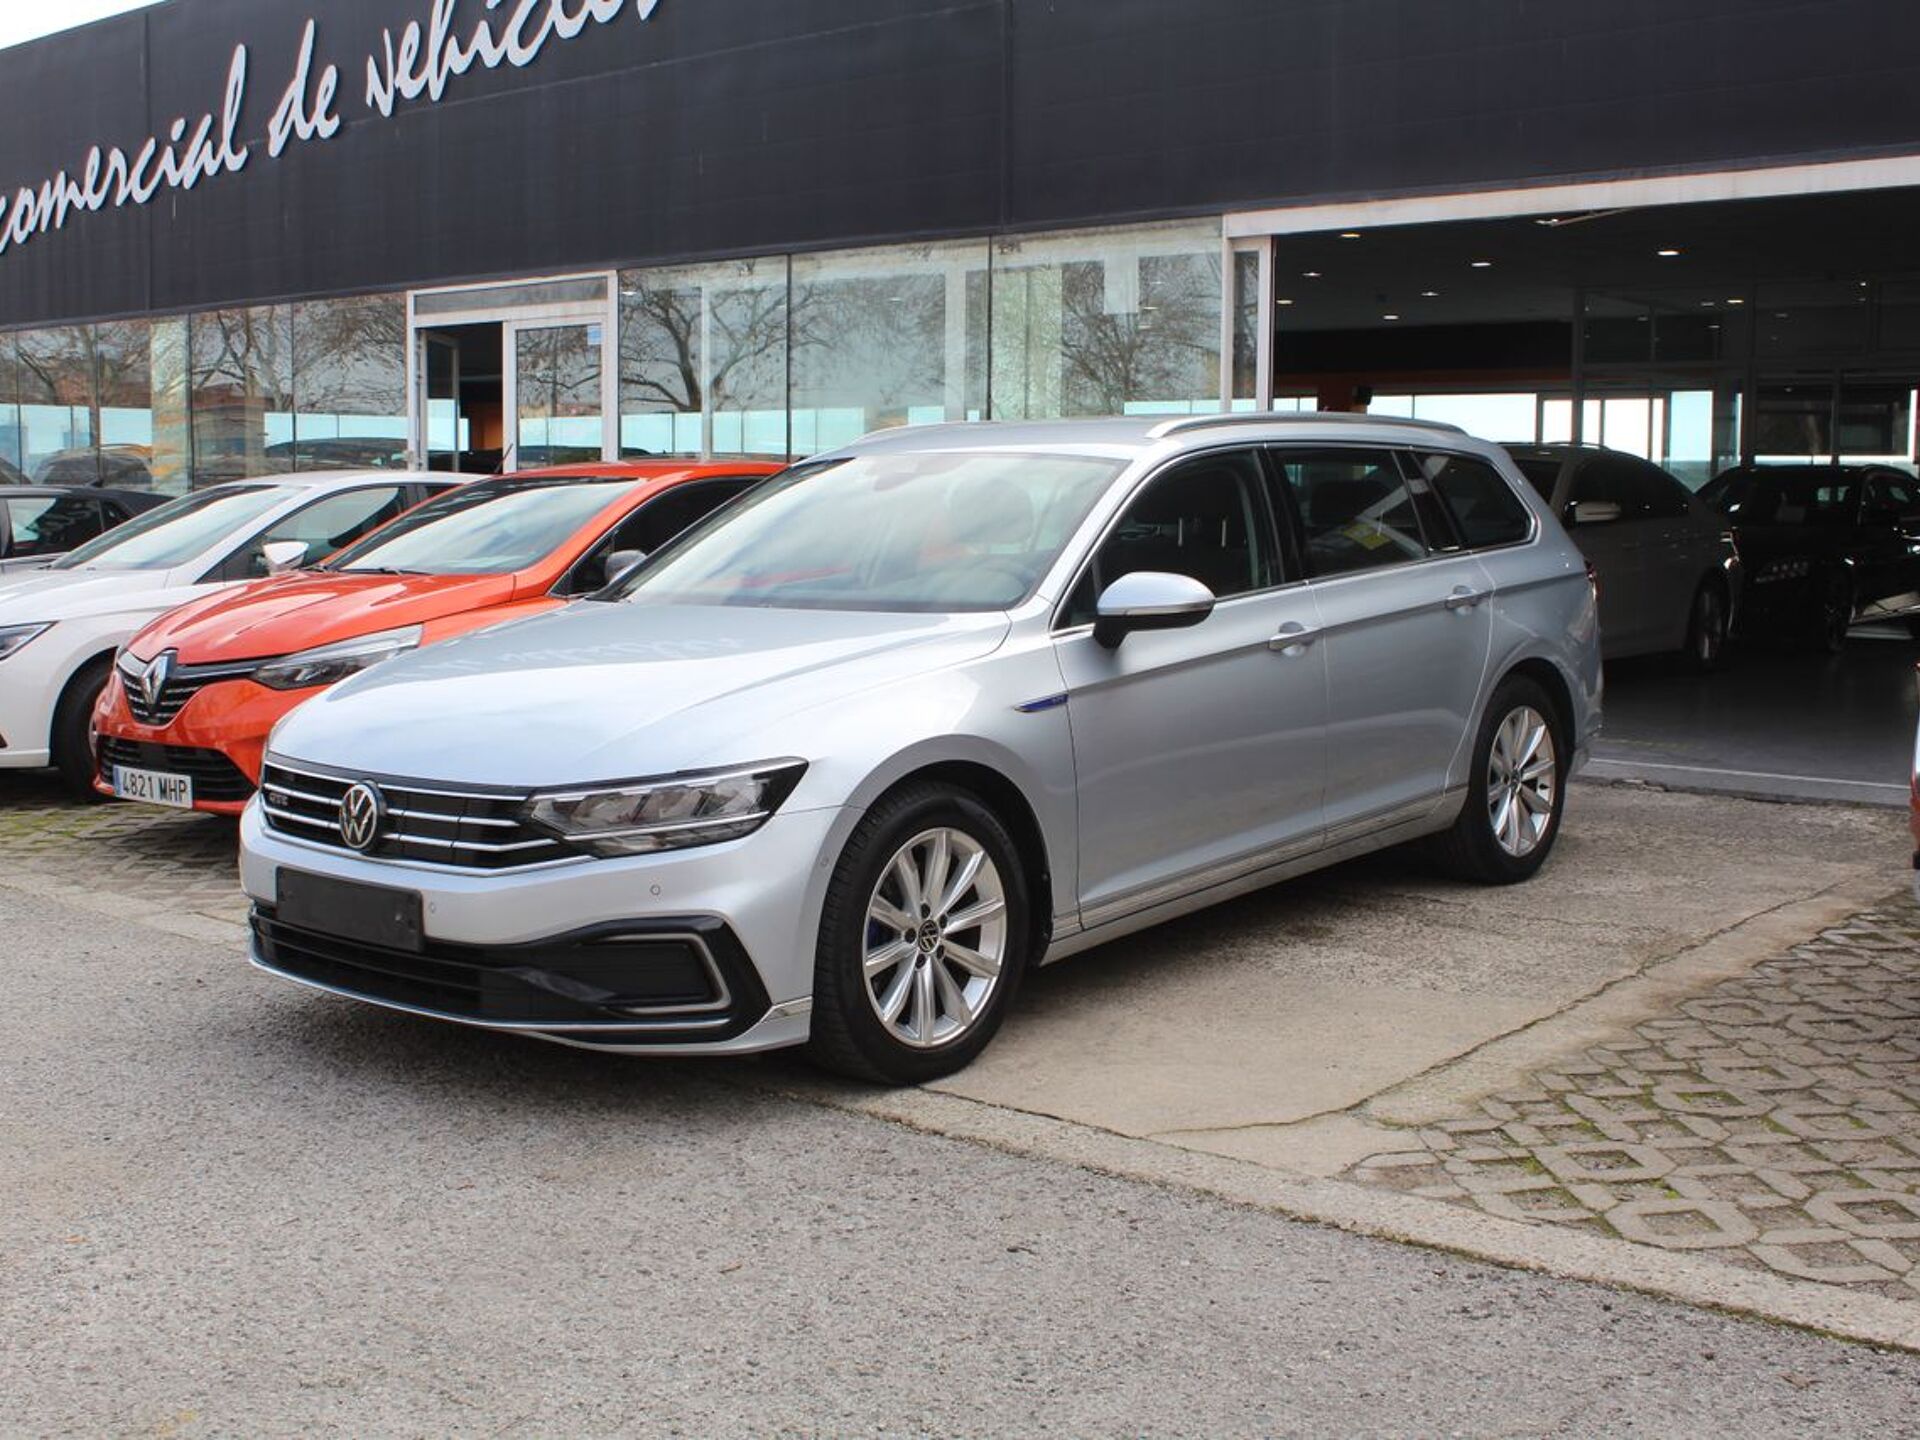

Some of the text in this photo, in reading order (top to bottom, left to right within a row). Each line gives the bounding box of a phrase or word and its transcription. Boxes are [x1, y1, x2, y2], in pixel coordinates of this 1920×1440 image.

[268, 19, 340, 158] de
[122, 771, 188, 803] 4821 MHP
